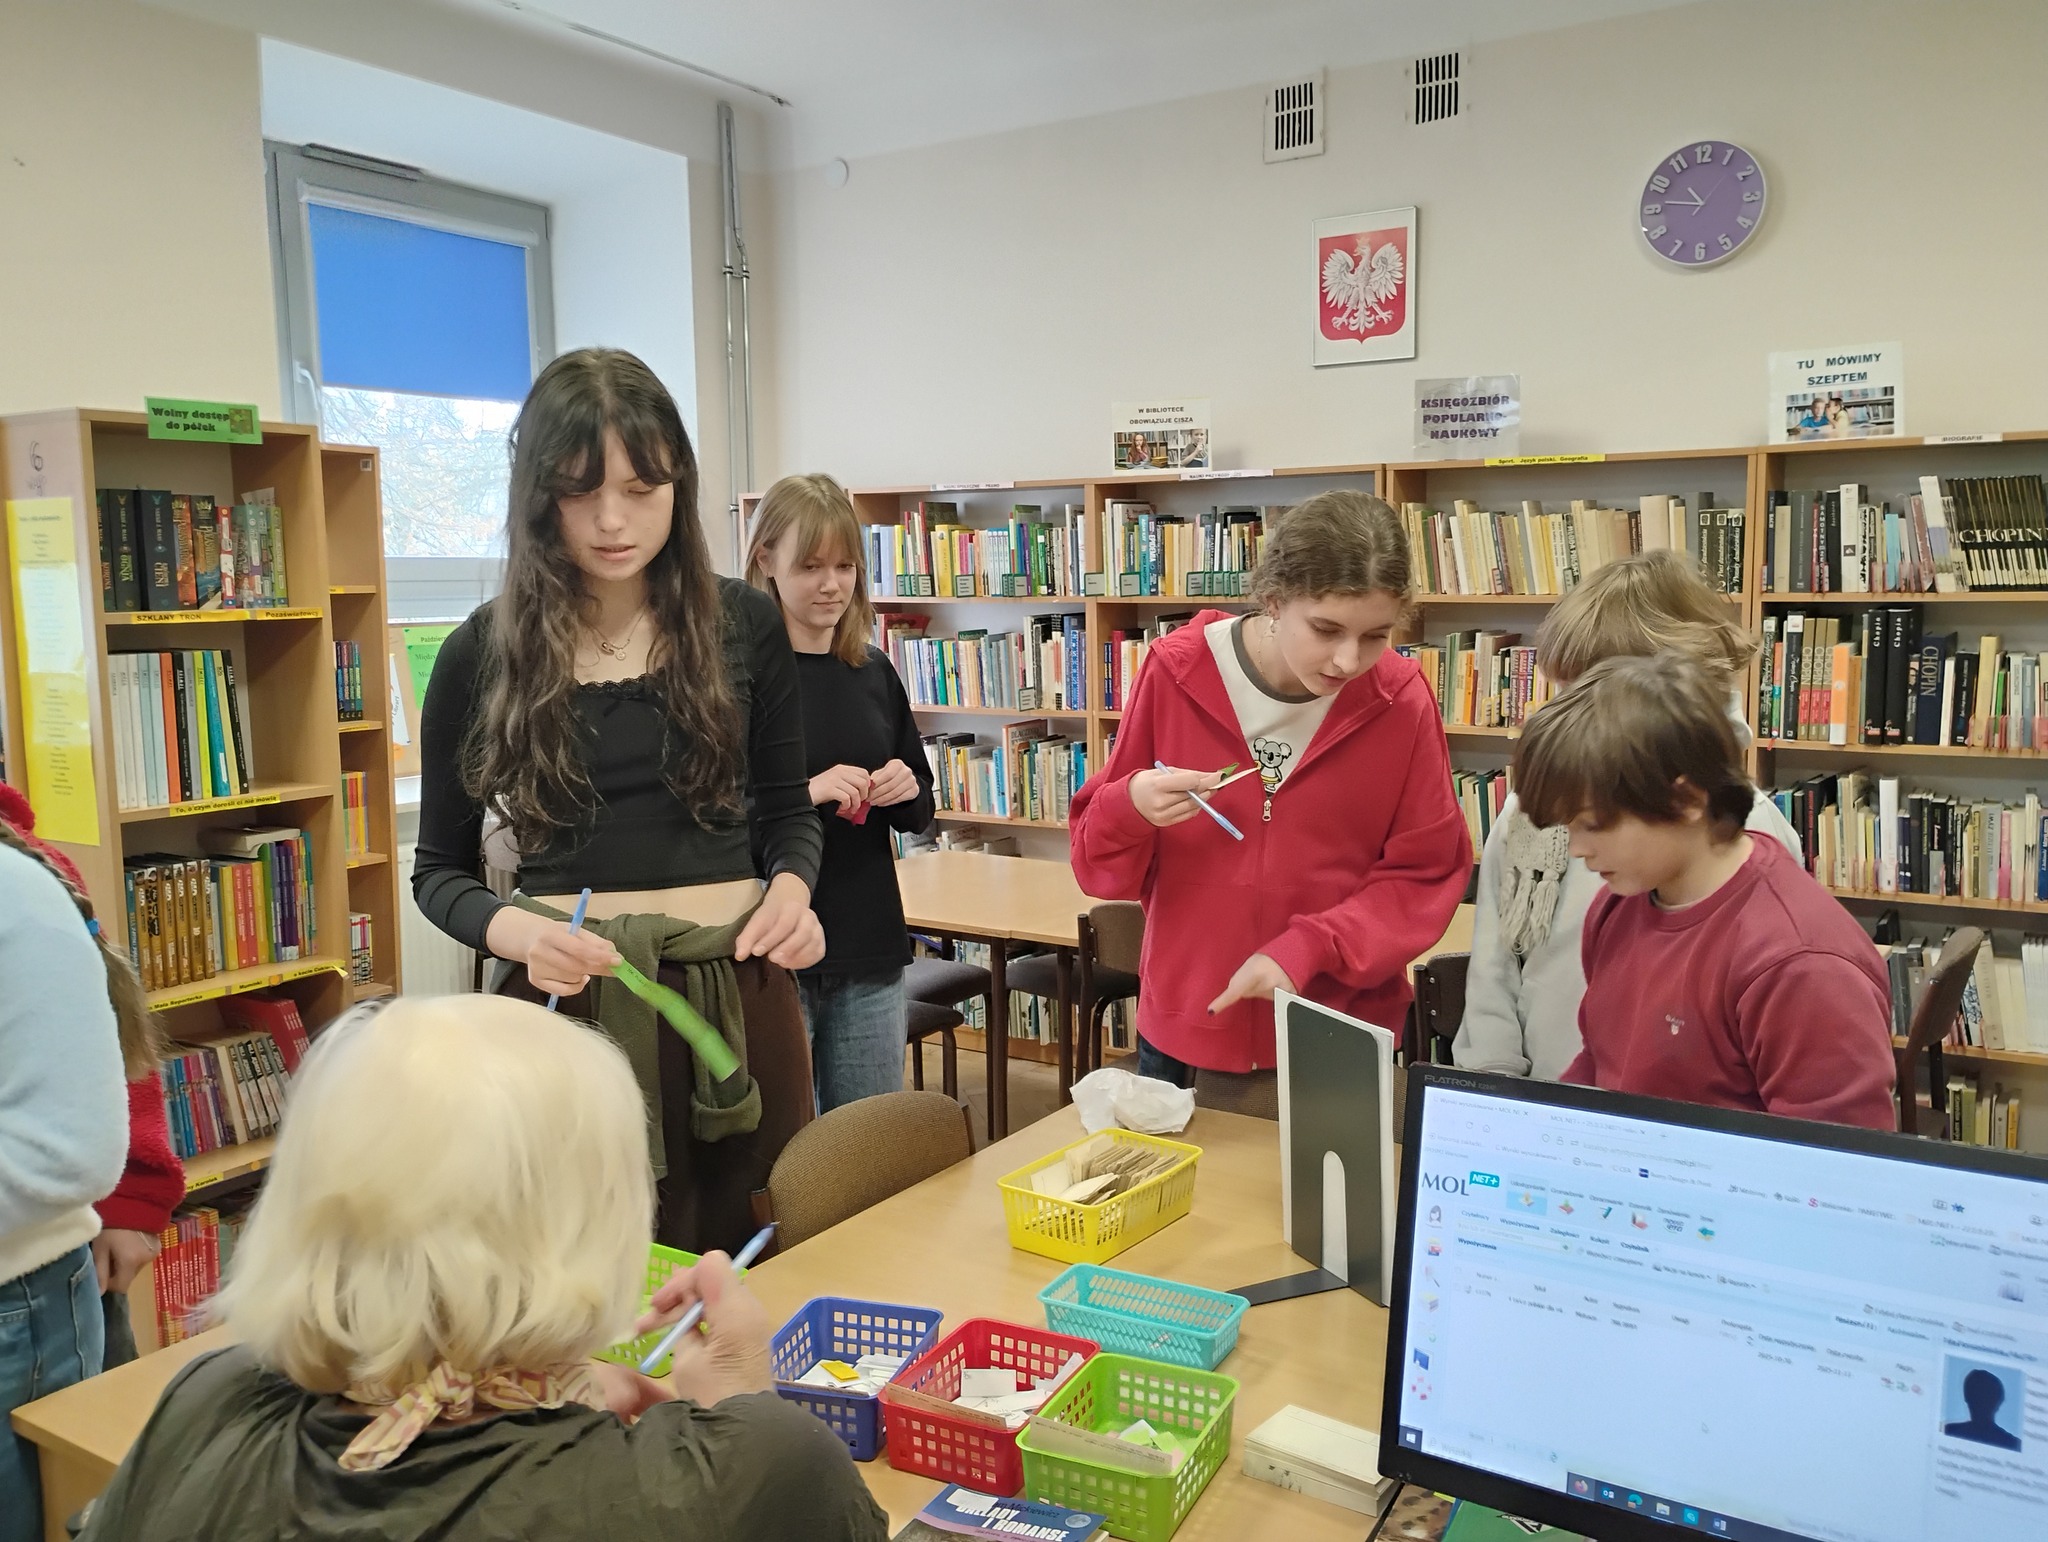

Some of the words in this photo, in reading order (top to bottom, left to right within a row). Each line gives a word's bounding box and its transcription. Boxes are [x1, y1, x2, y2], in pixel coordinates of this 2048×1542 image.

[1695, 144, 1712, 163] 12
[1722, 149, 1734, 165] 1
[1669, 153, 1688, 173] 11
[1736, 165, 1755, 181] 2
[1650, 175, 1670, 193] 10
[1743, 191, 1760, 202] 3
[1644, 204, 1661, 215] 9
[1736, 216, 1753, 229] 4
[1649, 225, 1667, 240] 8
[1669, 239, 1683, 256] 7
[1718, 233, 1732, 250] 5
[1695, 243, 1705, 260] 6
[1797, 360, 1814, 369] TU
[1826, 353, 1882, 367] MÓWIMY
[1807, 372, 1868, 385] SZEPTEM
[1421, 394, 1509, 408] KSIĘGOZBIÓR
[152, 408, 189, 419] Wolny
[192, 410, 230, 421] dostęp
[1423, 412, 1507, 424] POPULARNO-
[166, 421, 179, 429] do
[183, 422, 216, 431] półek
[1430, 428, 1499, 439] NAUKOWY
[31, 440, 43, 471] 6
[1960, 528, 2043, 543] CHOPIN
[154, 562, 163, 587] CIENI
[1873, 617, 1881, 647] Chopin
[1894, 617, 1902, 648] Chopin
[1801, 646, 1812, 685] CHOPIN
[1812, 646, 1824, 685] CHOPIN
[1920, 646, 1939, 696] CHOPIN
[193, 803, 211, 812] czym
[239, 981, 262, 989] Muminki
[170, 995, 203, 1005] Reporterka
[1424, 1074, 1477, 1088] FLATRON
[196, 1176, 218, 1187] Karolek
[1422, 1172, 1470, 1197] MOL
[1472, 1173, 1499, 1187] NET+
[1461, 1210, 1490, 1222] Czytelnicy
[1500, 1217, 1540, 1231] Wypożyczenia
[1620, 1241, 1650, 1253] Czytelnik
[1458, 1237, 1497, 1250] Wypożyczenia
[1009, 1502, 1060, 1518] Mickiewicz
[982, 1517, 991, 1528] I
[992, 1519, 1069, 1541] ROMANSE
